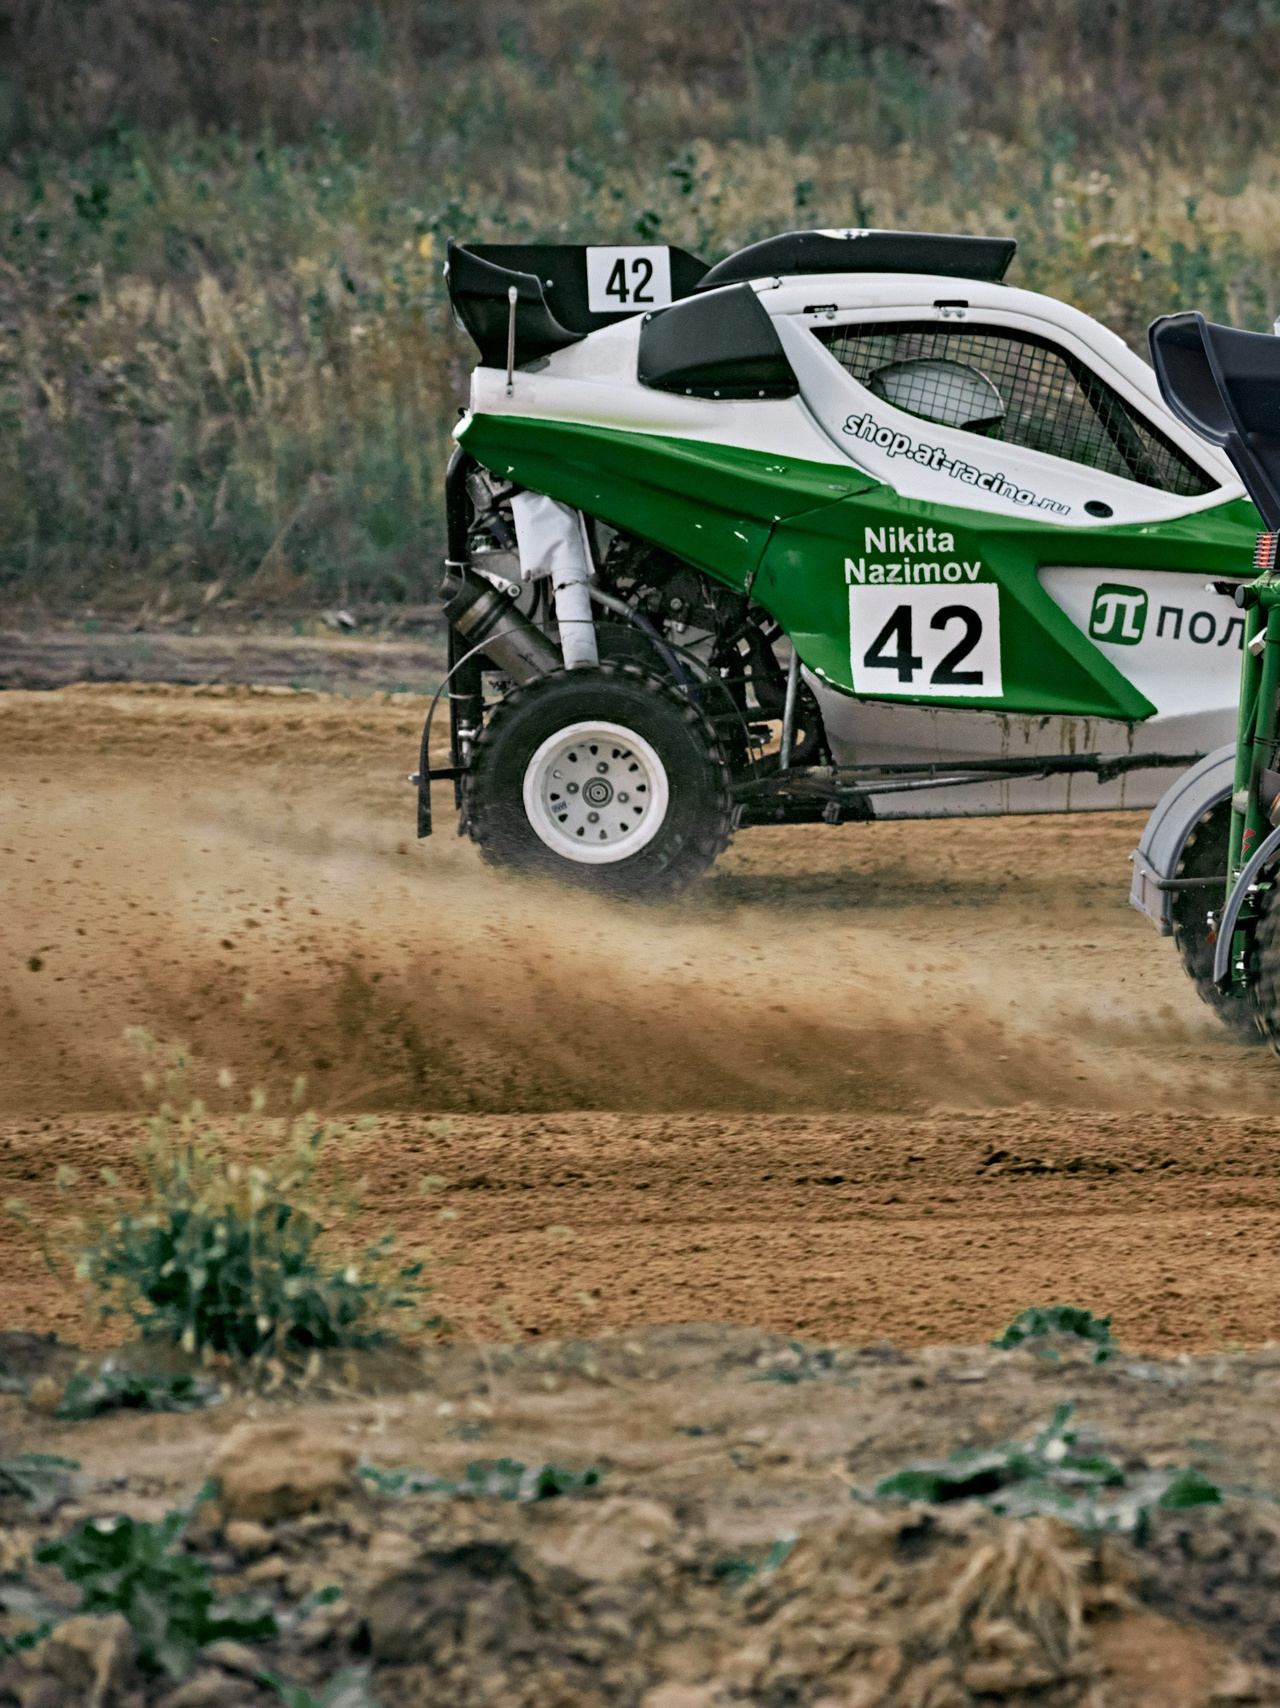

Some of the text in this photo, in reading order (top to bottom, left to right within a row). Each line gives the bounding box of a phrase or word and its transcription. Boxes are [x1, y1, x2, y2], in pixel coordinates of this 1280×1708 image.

[605, 258, 654, 303] 42
[842, 413, 1071, 516] shop.at-racing.ru
[865, 527, 954, 553] Nikita
[845, 559, 981, 584] Nazimov
[863, 605, 983, 685] 42
